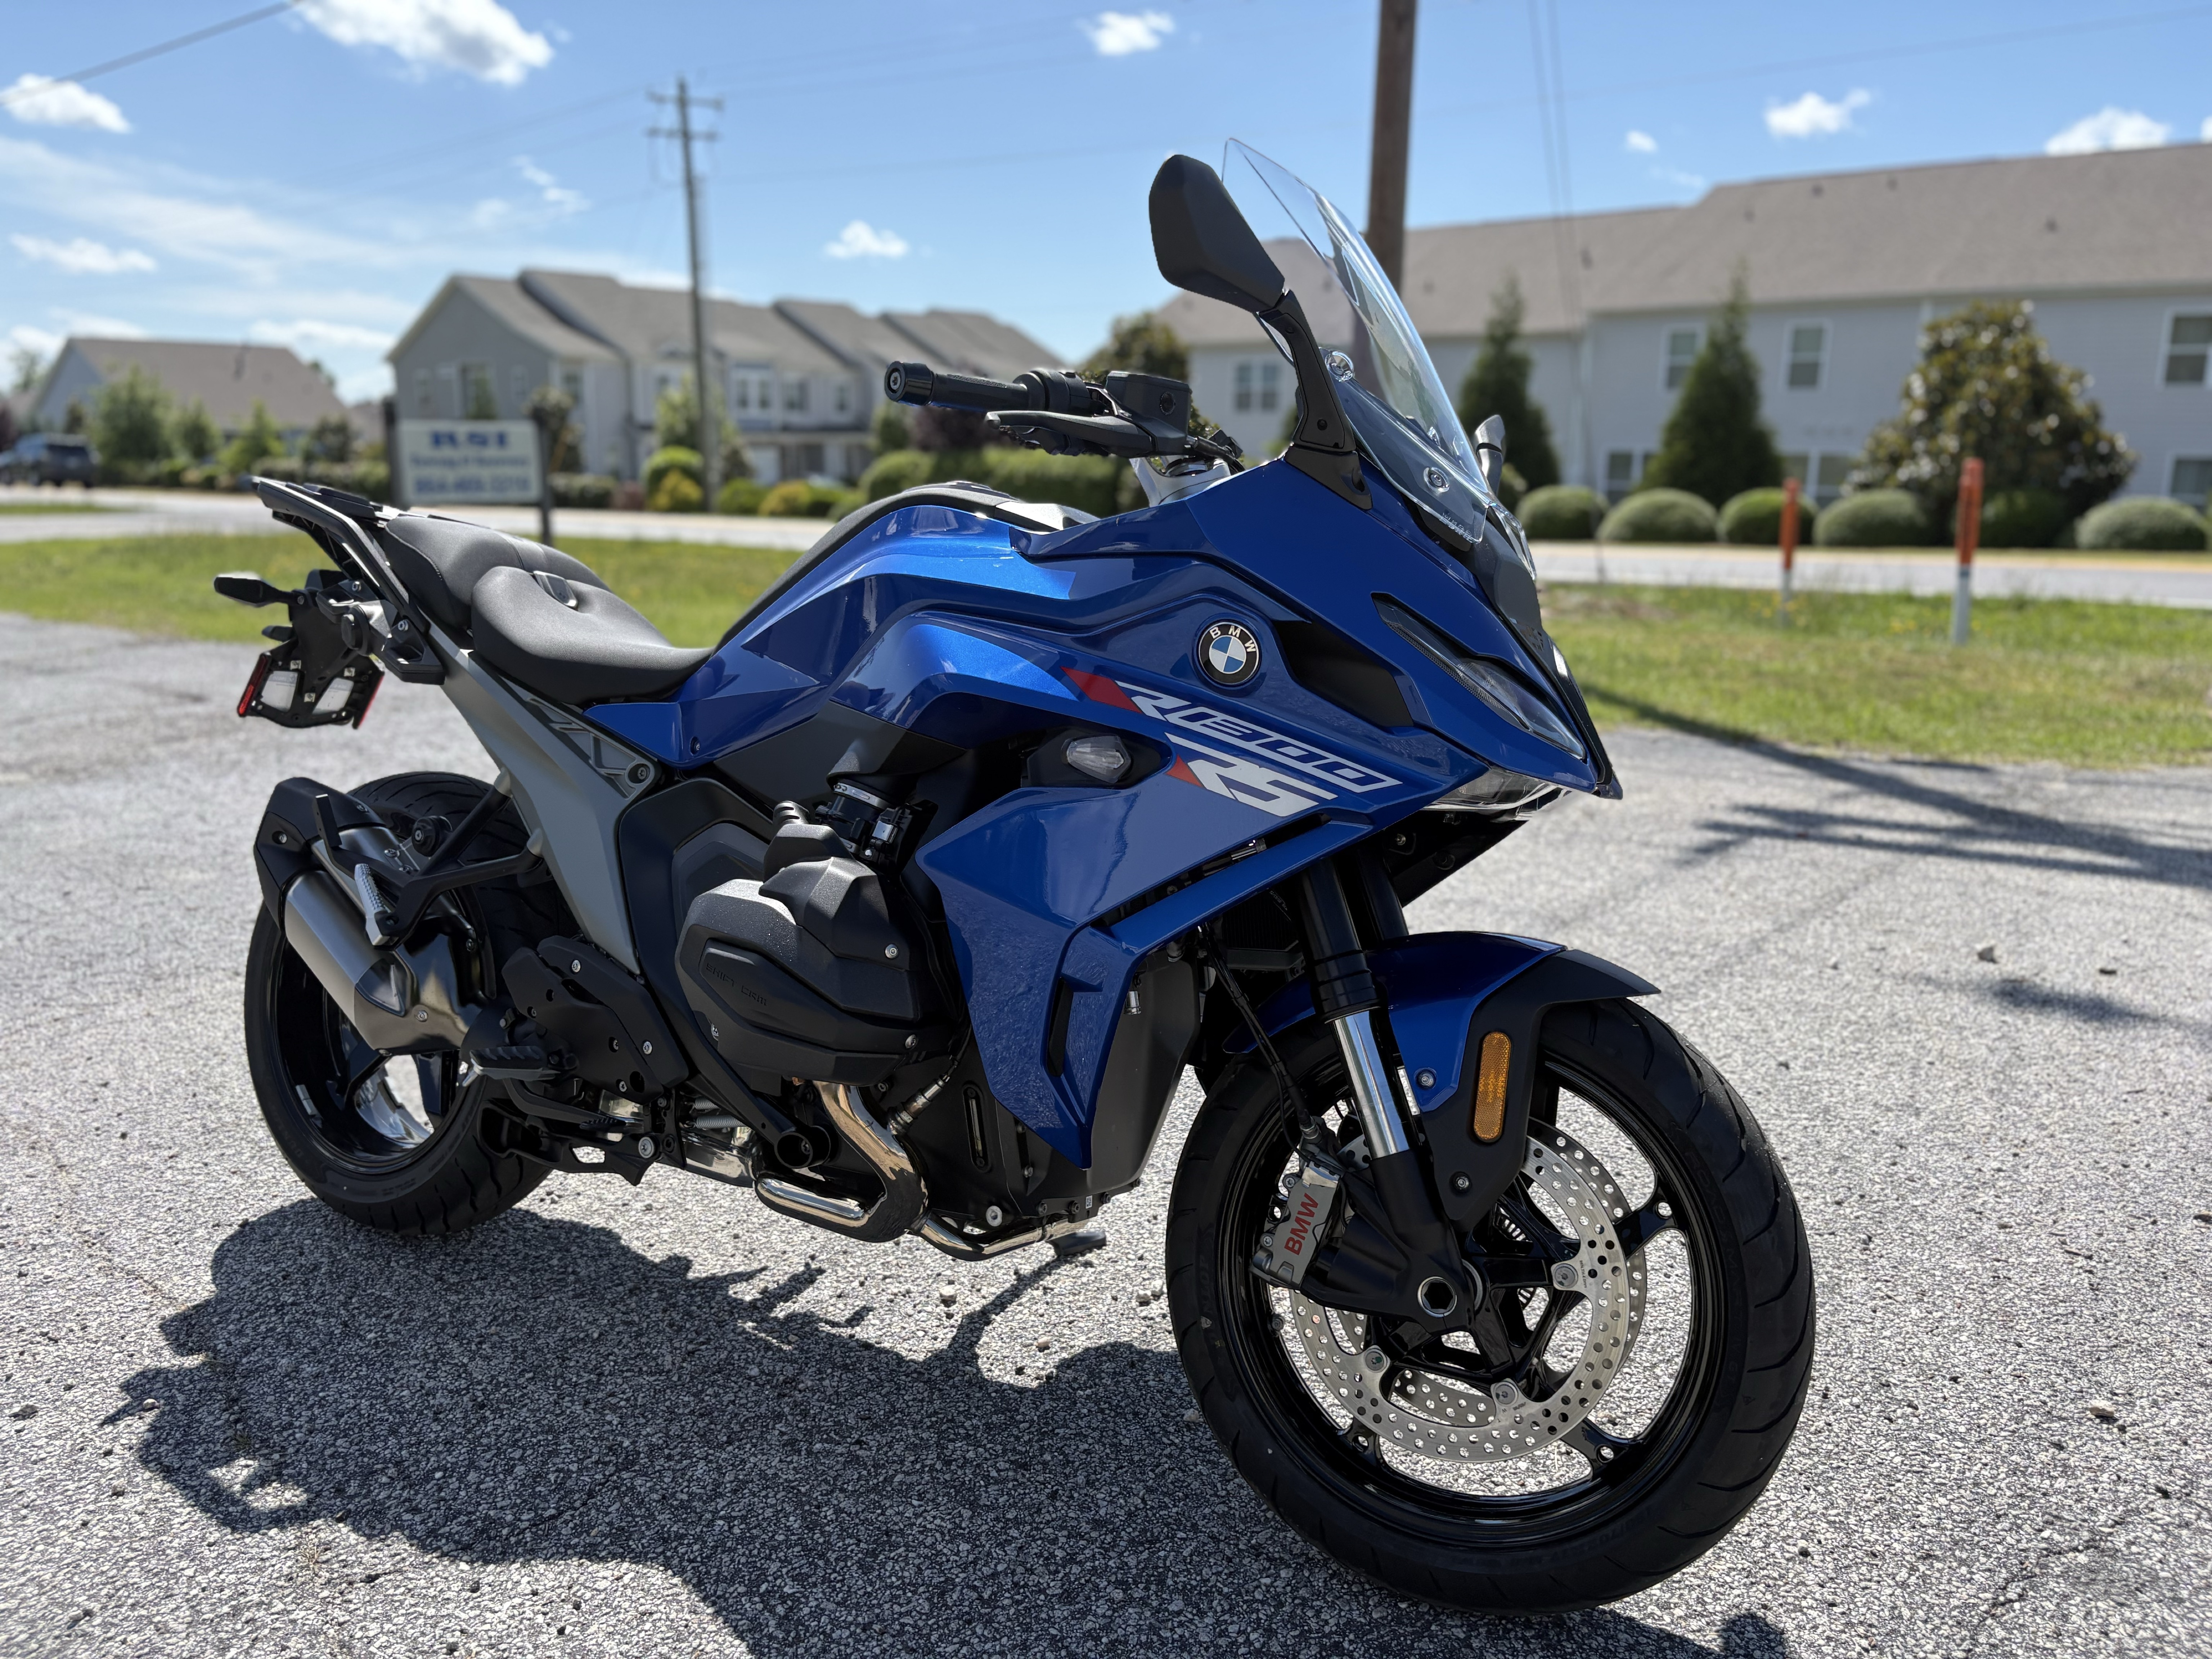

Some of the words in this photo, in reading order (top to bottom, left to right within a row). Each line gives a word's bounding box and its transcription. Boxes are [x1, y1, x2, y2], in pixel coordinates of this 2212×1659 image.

[1209, 625, 1256, 652] BMW
[1165, 732, 1337, 817] RS
[1284, 1193, 1319, 1255] BMW
